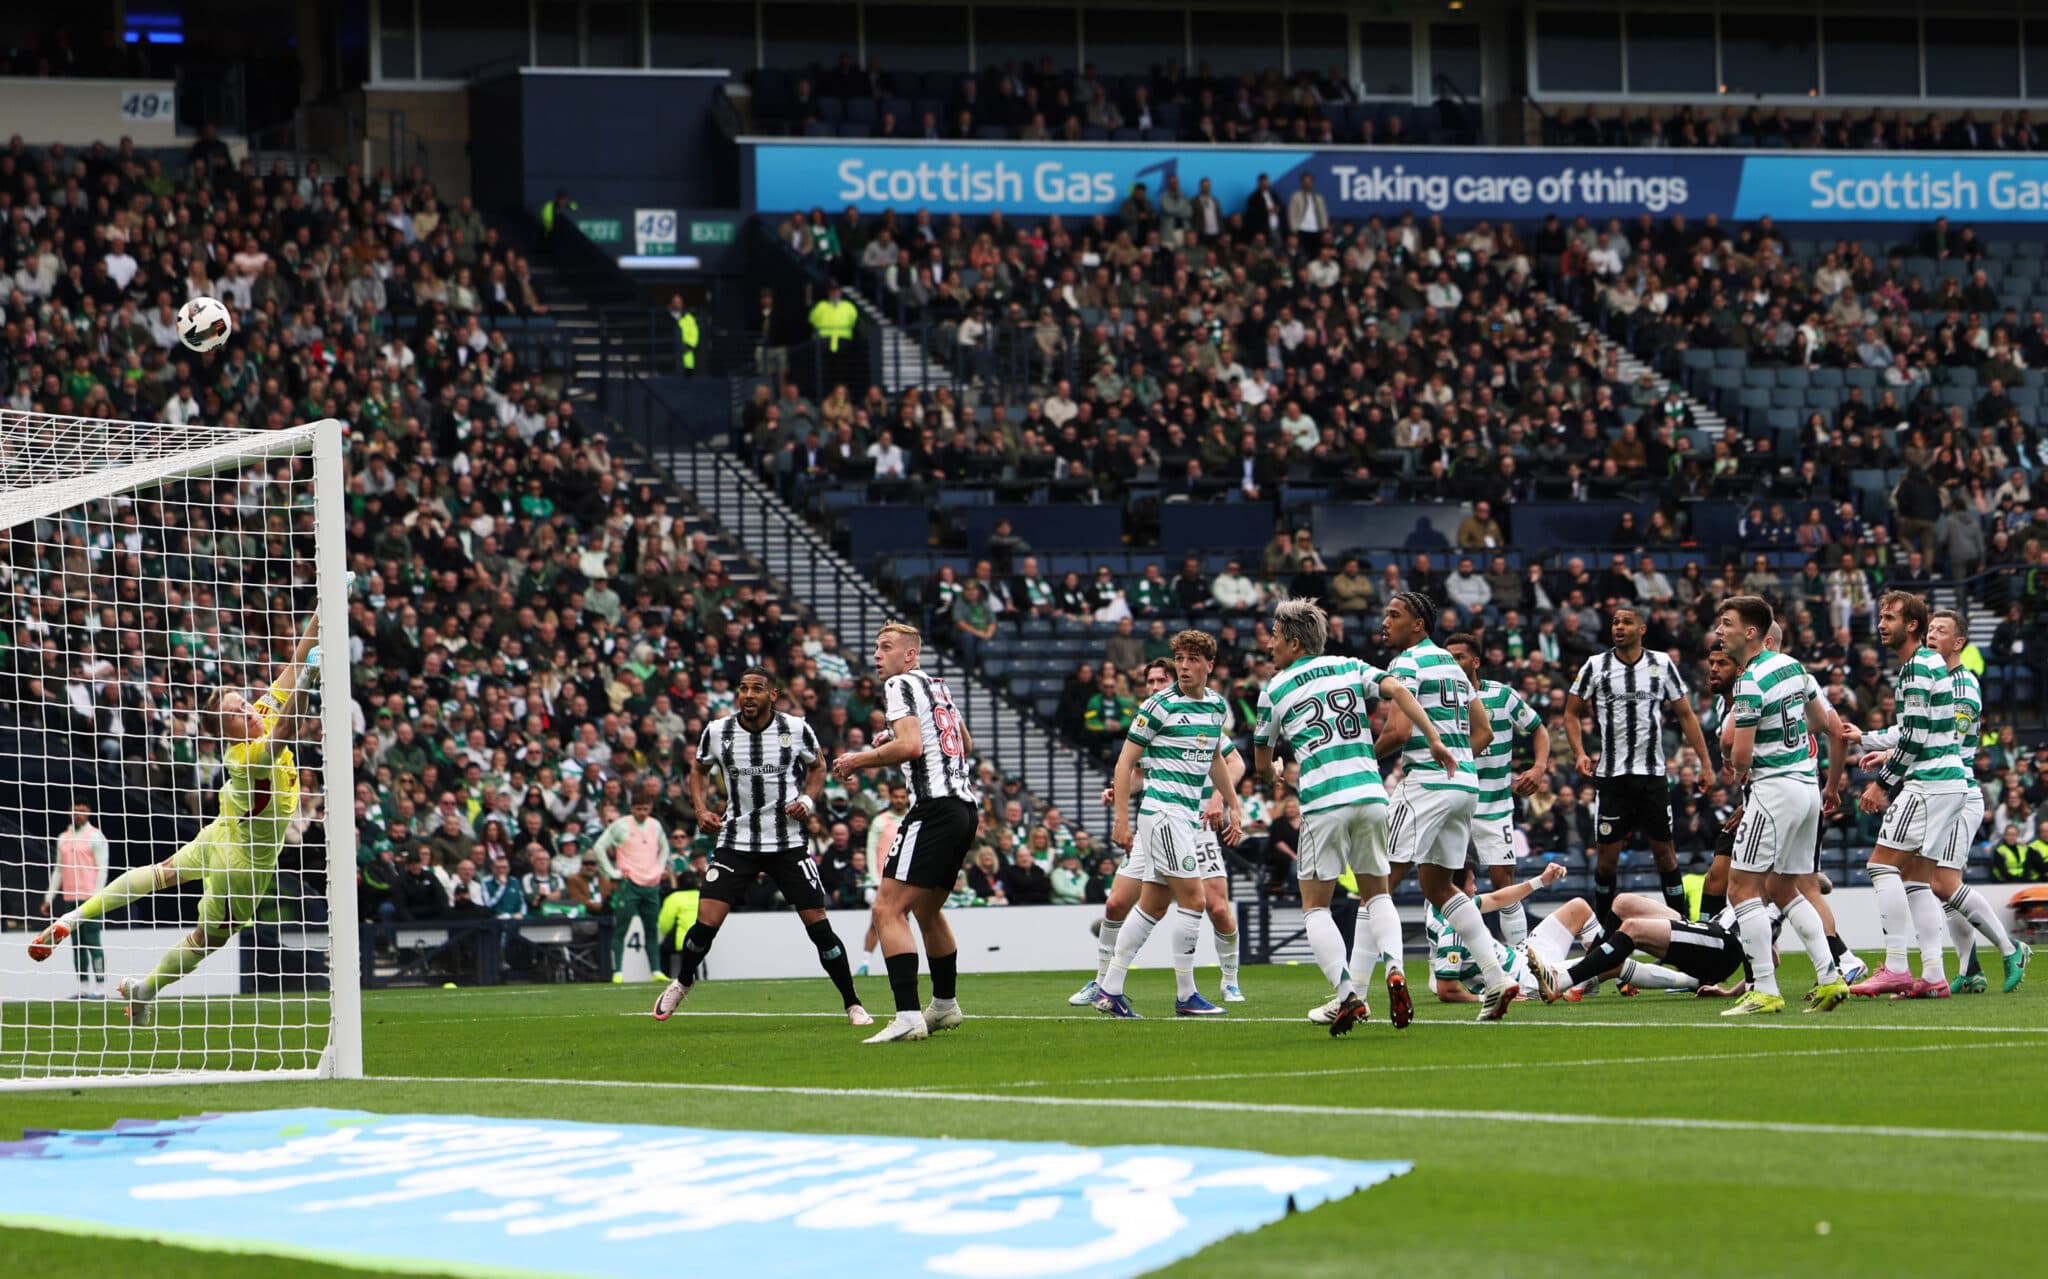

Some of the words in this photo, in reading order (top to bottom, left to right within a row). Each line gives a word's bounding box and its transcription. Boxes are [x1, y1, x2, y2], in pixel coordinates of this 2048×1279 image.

[837, 158, 1023, 202] Scottish
[1033, 162, 1116, 203] Gas
[1332, 165, 1449, 211] Taking
[1453, 175, 1533, 204] care
[1537, 167, 1575, 204] of
[1578, 167, 1689, 213] things
[1810, 169, 1978, 210] Scottish
[640, 213, 674, 238] 49
[692, 222, 731, 242] EXIT
[1294, 664, 1336, 688] DAIZEN
[1293, 687, 1362, 752] 38
[888, 833, 903, 857] 8
[1502, 825, 1513, 845] 6
[1735, 822, 1748, 844] 3
[1194, 842, 1218, 863] 56
[798, 857, 818, 880] 10
[626, 931, 642, 953] 4
